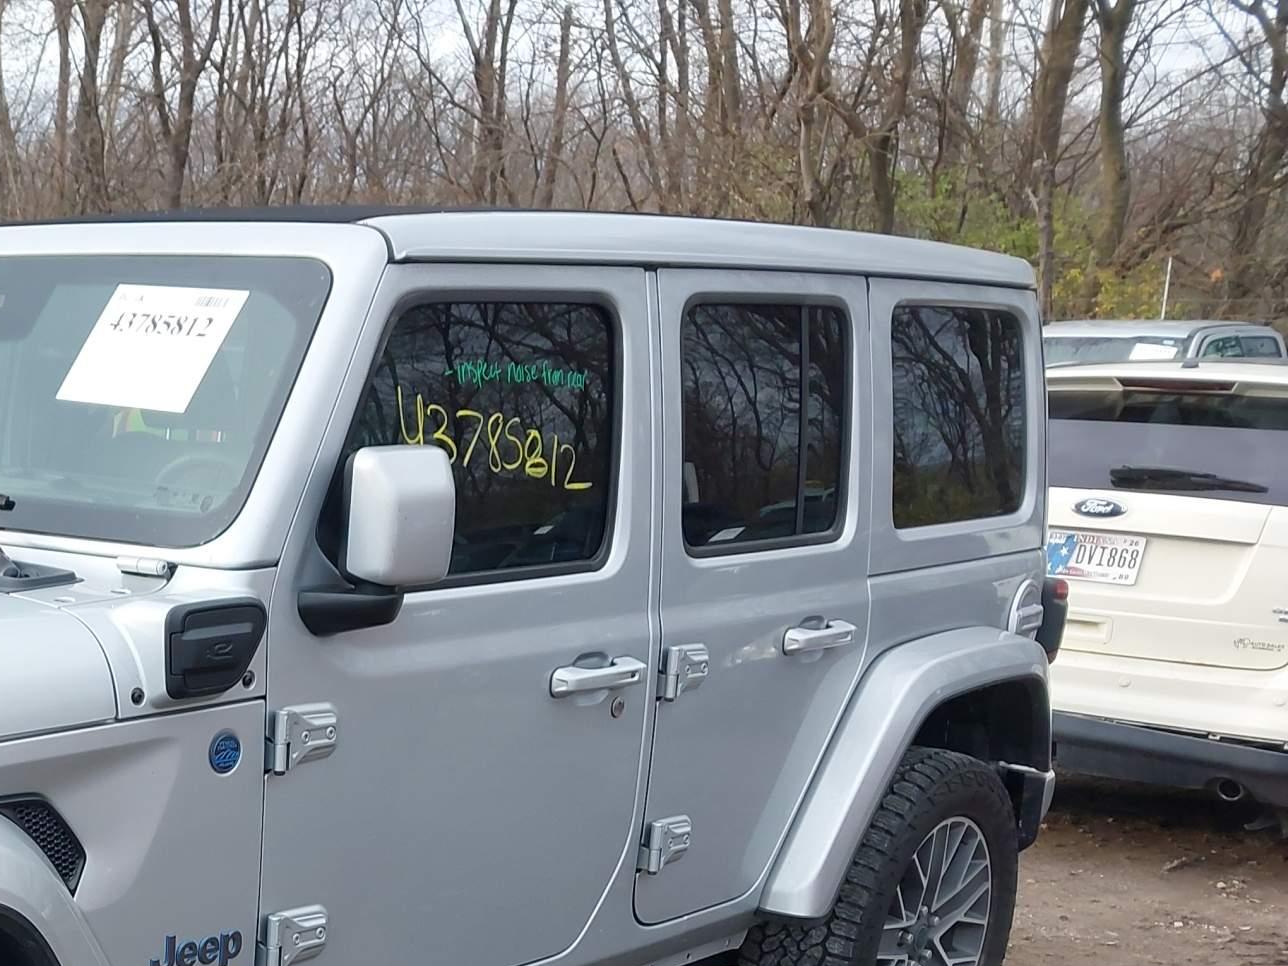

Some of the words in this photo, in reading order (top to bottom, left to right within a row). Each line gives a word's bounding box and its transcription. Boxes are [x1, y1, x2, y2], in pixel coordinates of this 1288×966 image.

[110, 312, 214, 337] 43785812
[397, 385, 593, 490] 43785812
[1075, 544, 1140, 569] DVI868
